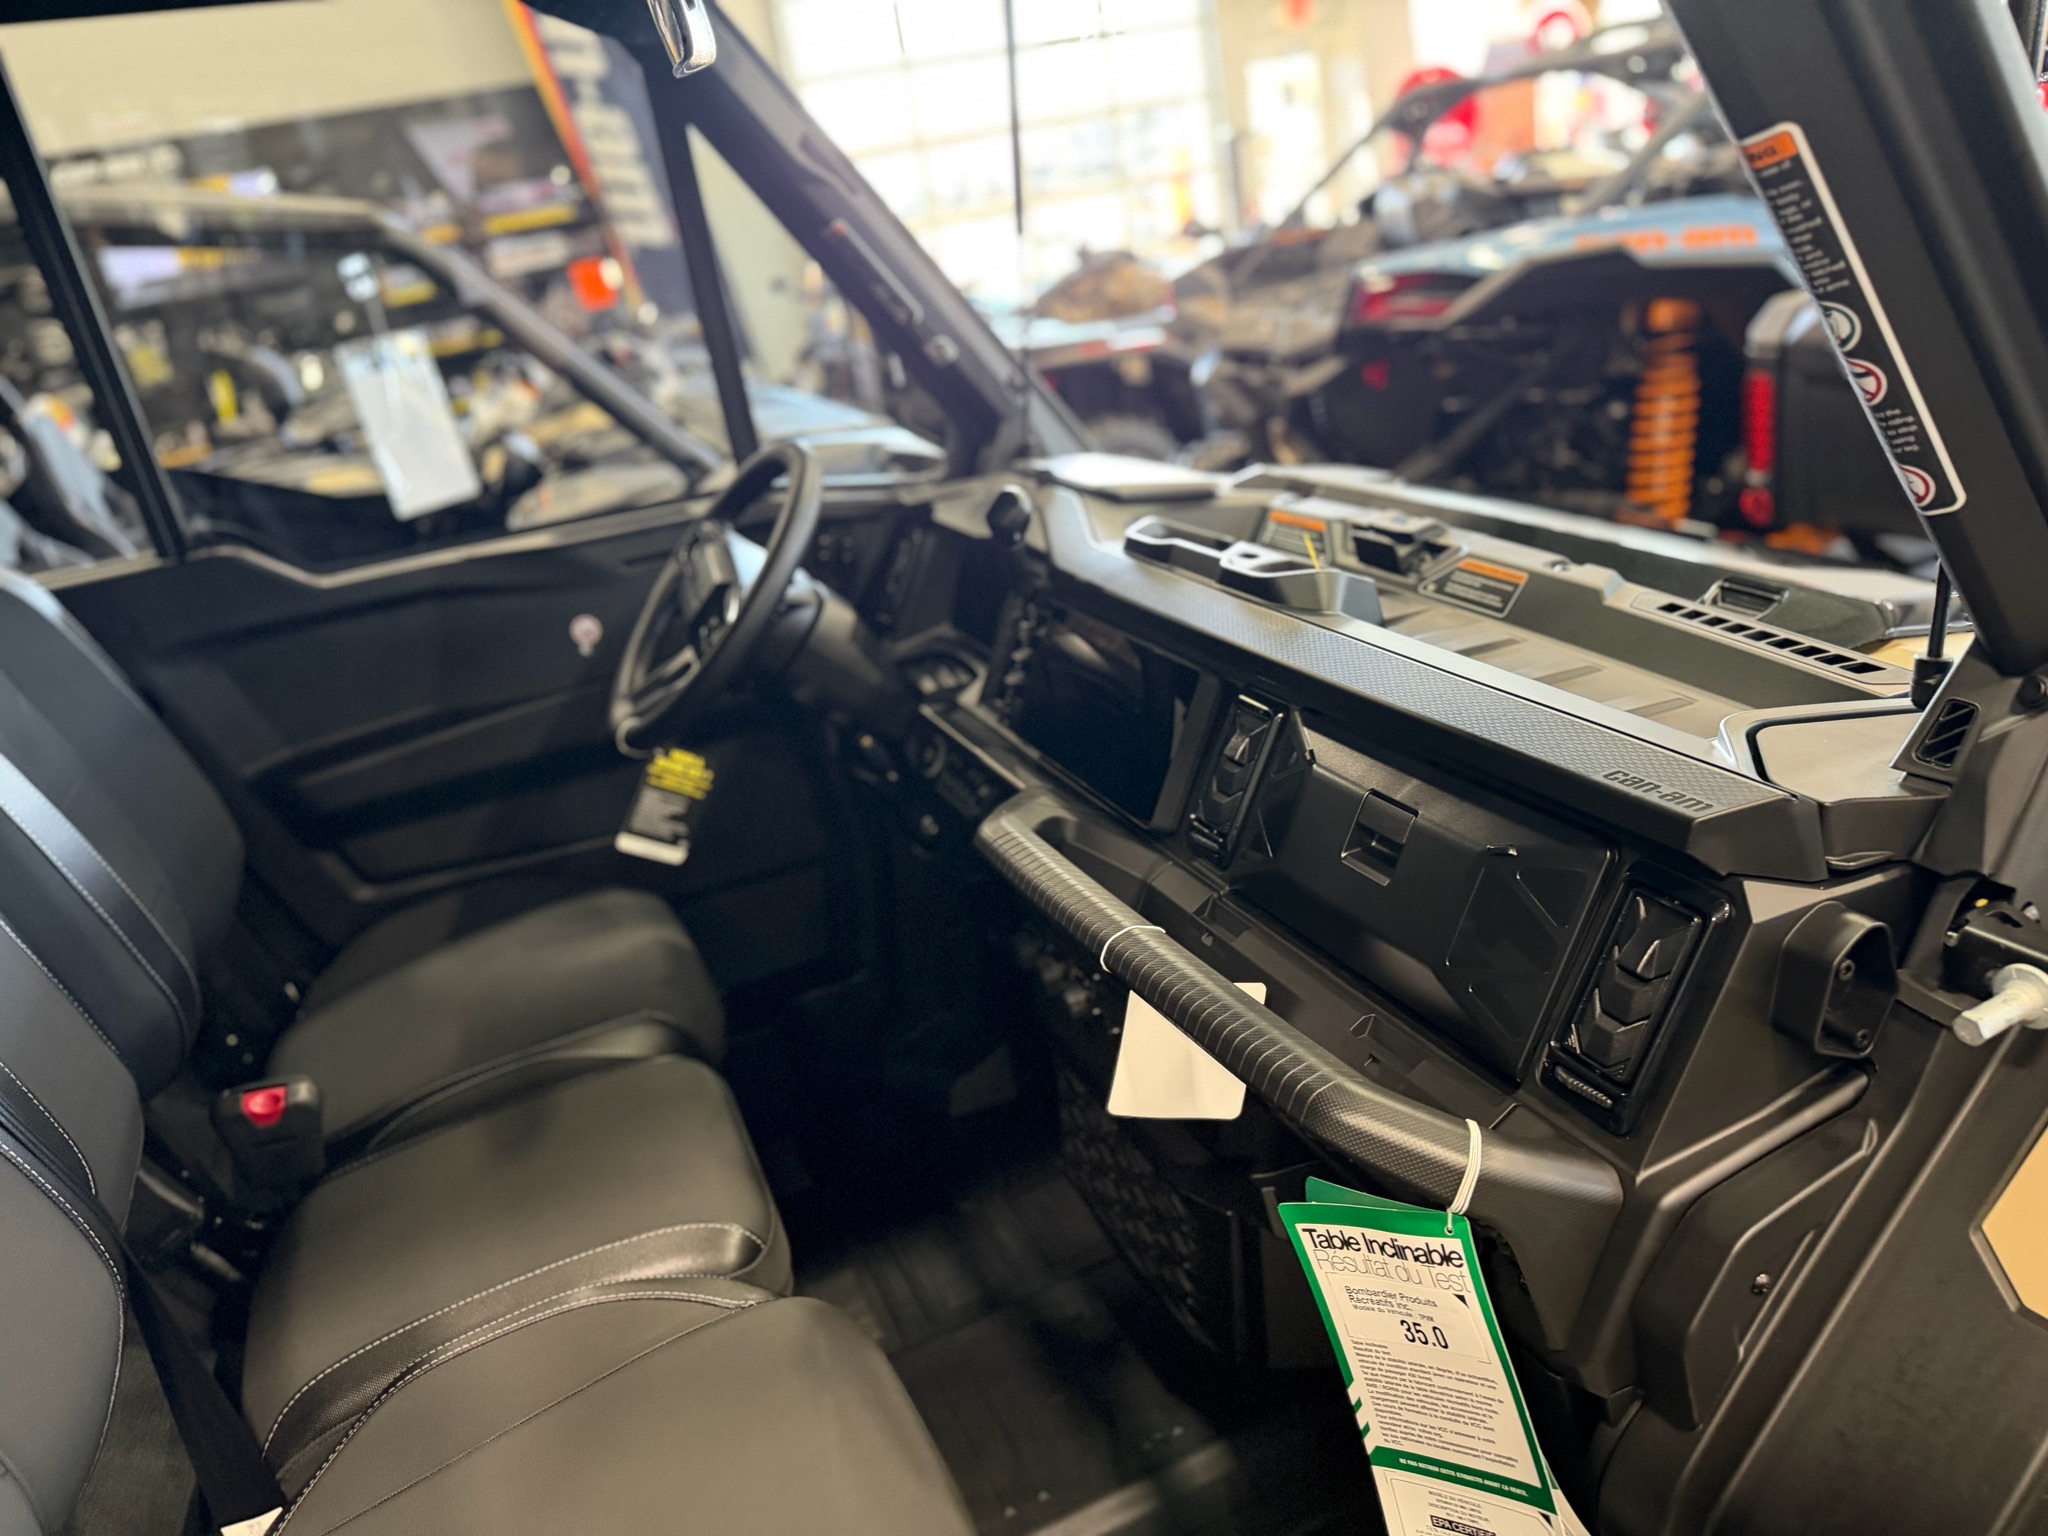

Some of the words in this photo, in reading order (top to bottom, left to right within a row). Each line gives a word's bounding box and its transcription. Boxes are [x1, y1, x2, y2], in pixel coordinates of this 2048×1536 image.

[1602, 770, 1714, 813] can-am
[1301, 1228, 1362, 1252] Table
[1361, 1232, 1465, 1268] Inclinable
[1313, 1249, 1394, 1279] Résultat
[1396, 1262, 1423, 1286] du
[1421, 1265, 1472, 1293] Test
[1344, 1286, 1398, 1300] Bombardier
[1399, 1292, 1438, 1308] Produits
[1399, 1319, 1449, 1349] 35.0
[1432, 1517, 1452, 1530] EPA
